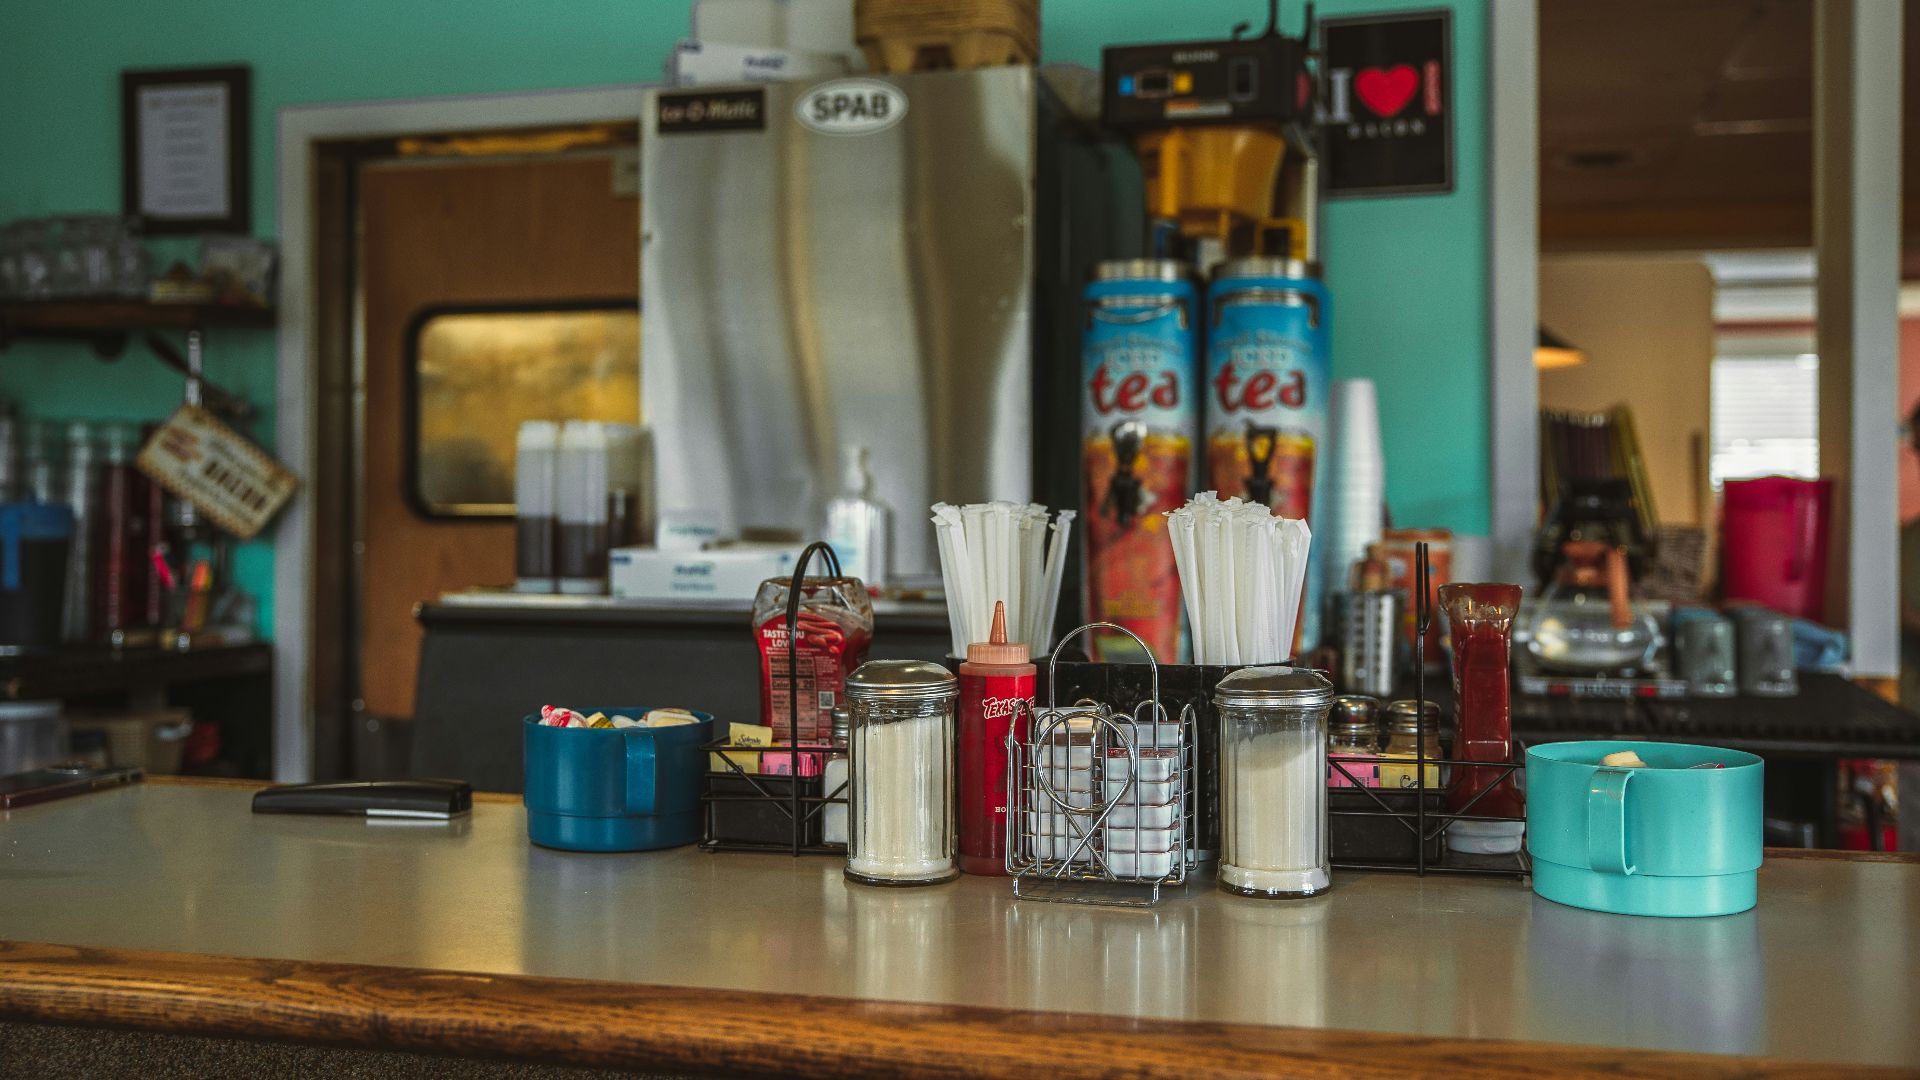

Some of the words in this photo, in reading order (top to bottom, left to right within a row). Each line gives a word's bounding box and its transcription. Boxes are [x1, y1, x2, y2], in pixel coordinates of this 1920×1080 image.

[811, 92, 892, 123] SPAB
[1089, 363, 1179, 416] tea
[1215, 362, 1307, 416] tea
[763, 629, 786, 638] TASTE
[772, 638, 790, 647] LOV
[982, 696, 1016, 719] TEXAS
